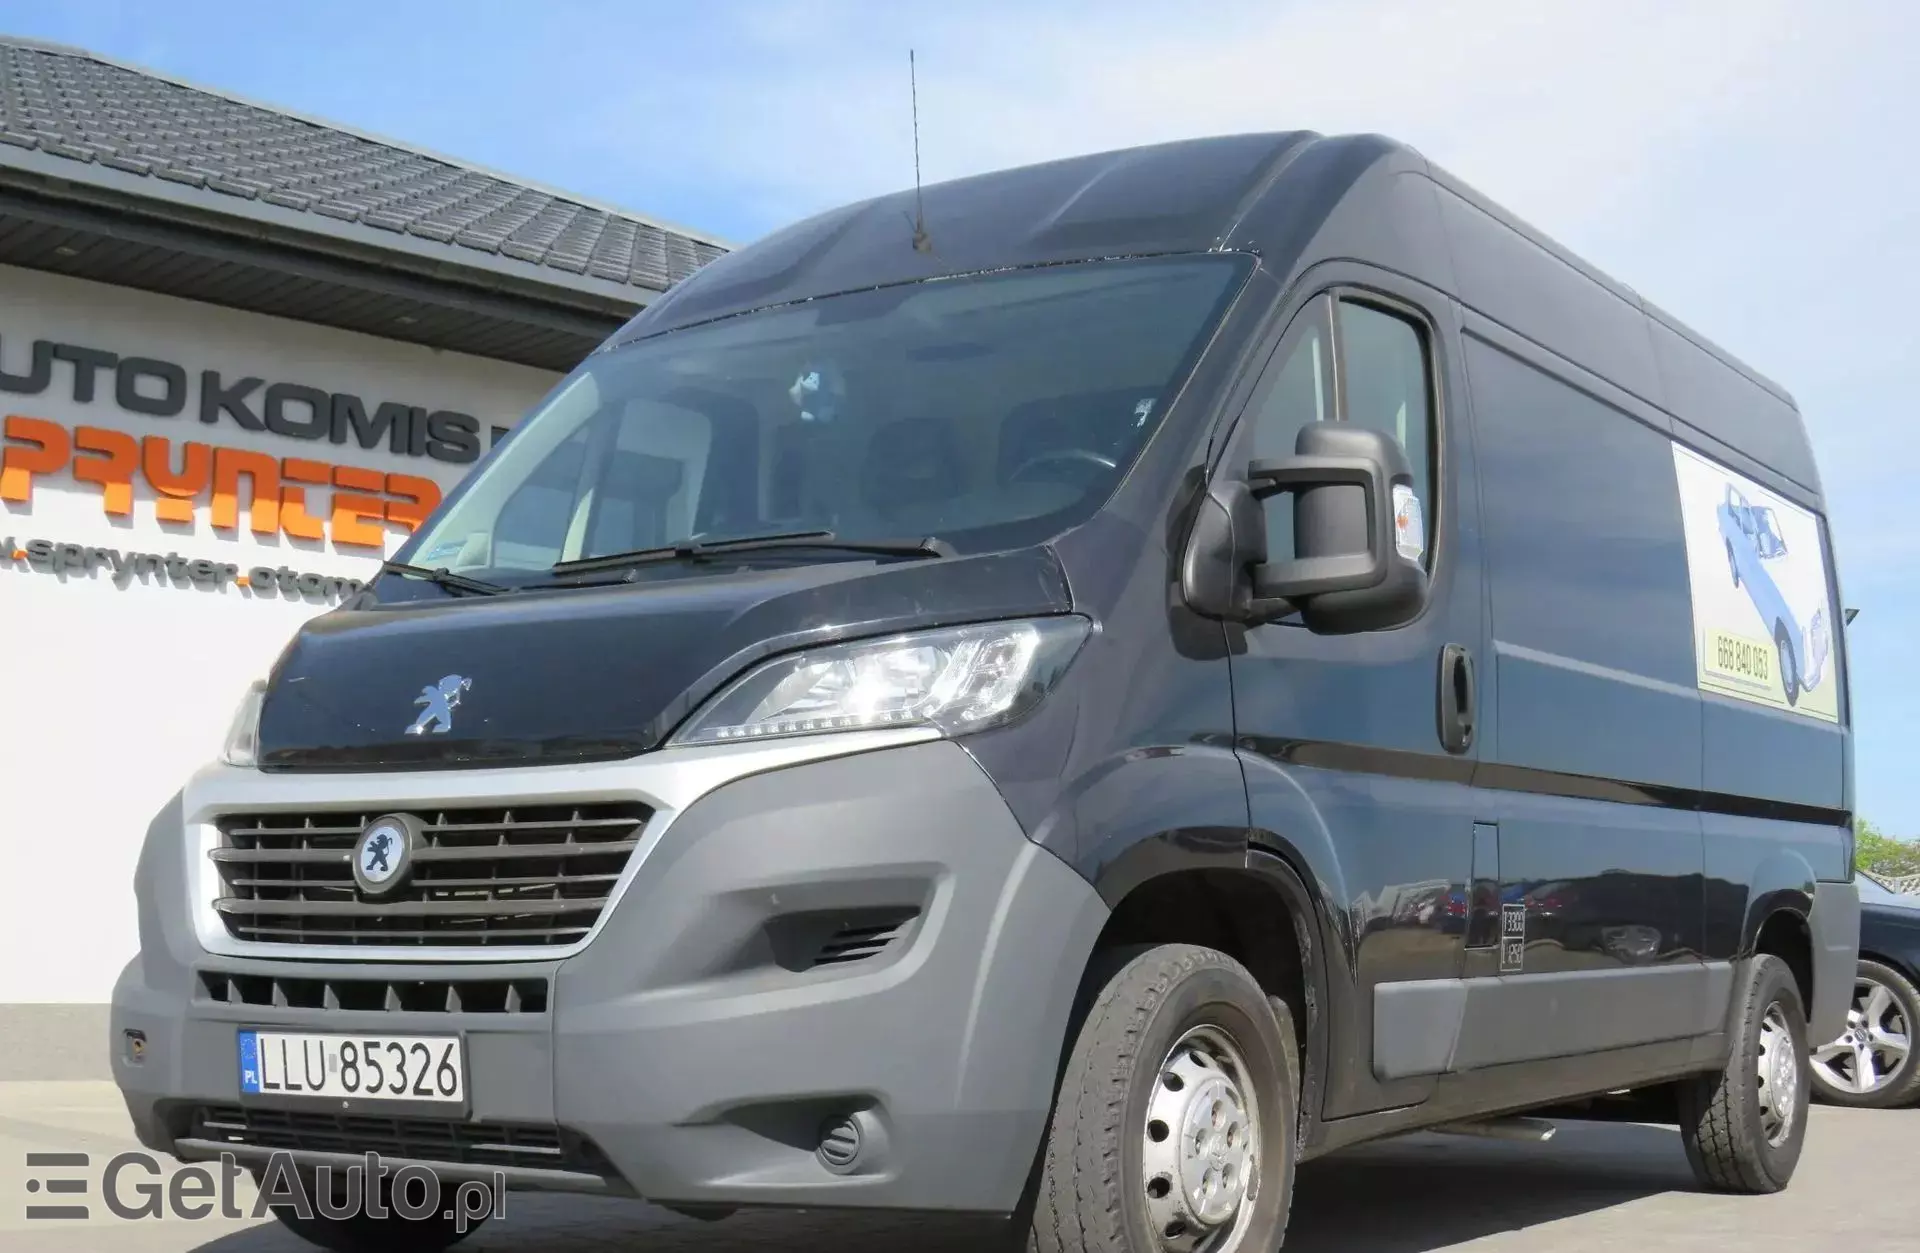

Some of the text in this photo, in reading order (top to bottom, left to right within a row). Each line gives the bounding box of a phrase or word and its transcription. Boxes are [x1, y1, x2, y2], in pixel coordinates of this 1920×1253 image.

[201, 370, 481, 464] KOMIS
[1735, 642, 1752, 675] 840
[245, 1070, 257, 1084] PL
[261, 1038, 457, 1097] LLU 85326
